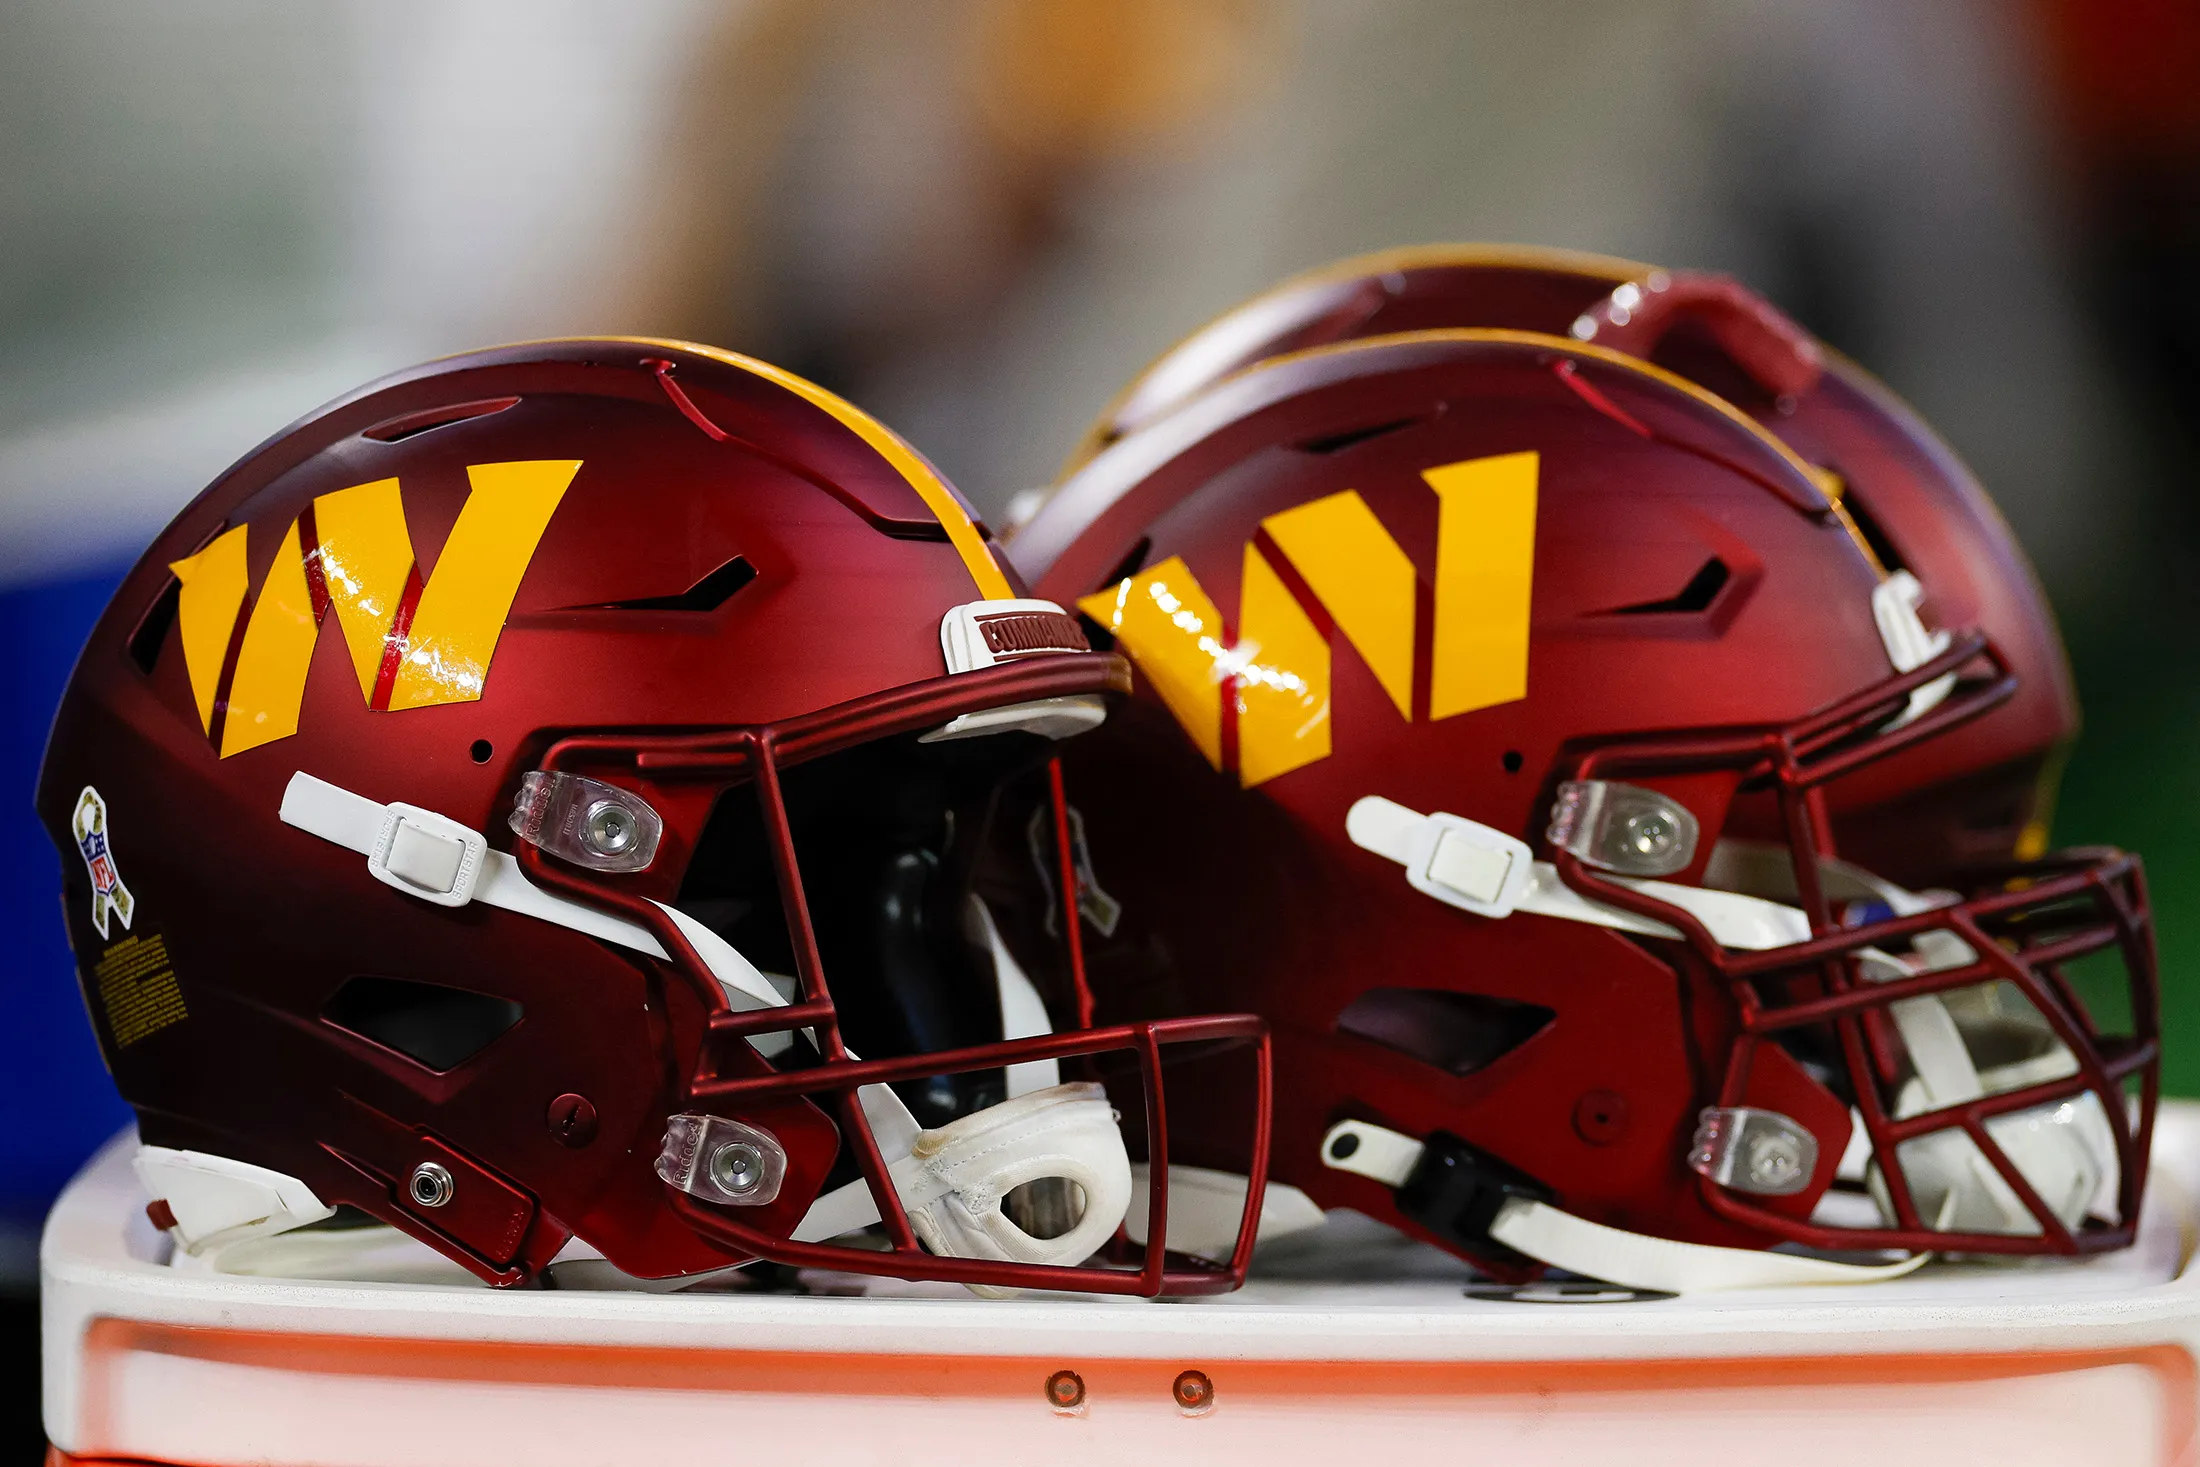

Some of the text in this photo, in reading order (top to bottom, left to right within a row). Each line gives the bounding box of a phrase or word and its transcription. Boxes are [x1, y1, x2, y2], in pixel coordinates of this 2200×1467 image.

[169, 460, 584, 760] W
[1077, 451, 1540, 790] W
[453, 841, 478, 899] SPORTSTAR
